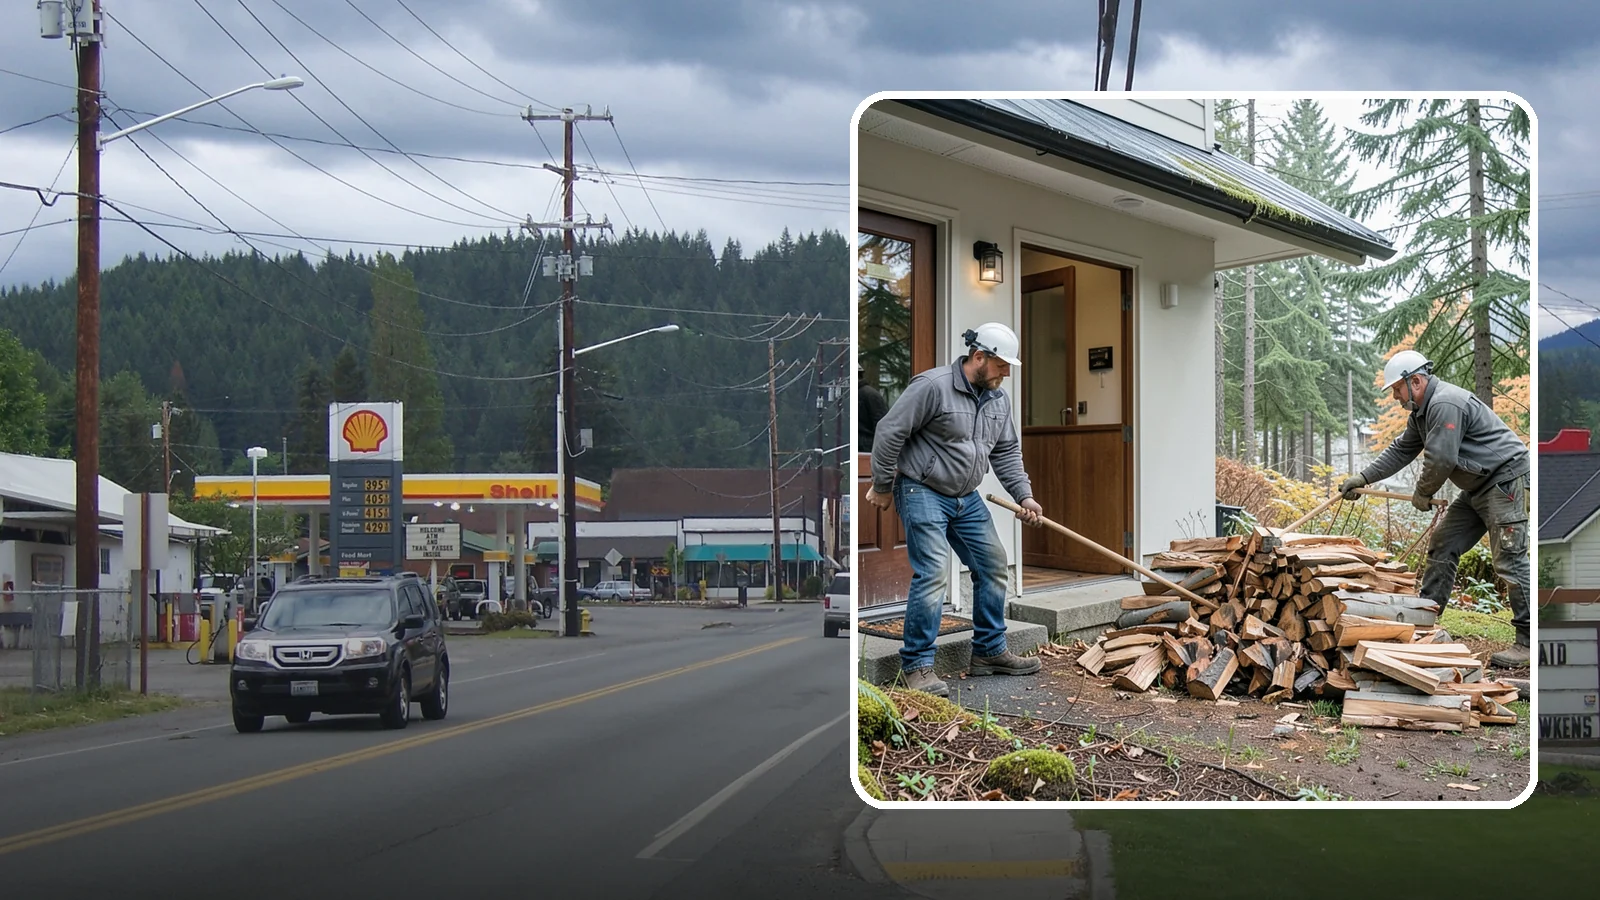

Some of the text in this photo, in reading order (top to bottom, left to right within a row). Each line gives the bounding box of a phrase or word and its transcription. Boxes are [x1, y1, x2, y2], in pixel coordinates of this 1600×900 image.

[365, 480, 383, 490] 395
[490, 484, 547, 499] Shell
[365, 494, 383, 504] 405
[365, 508, 383, 518] 415
[365, 522, 383, 533] 429
